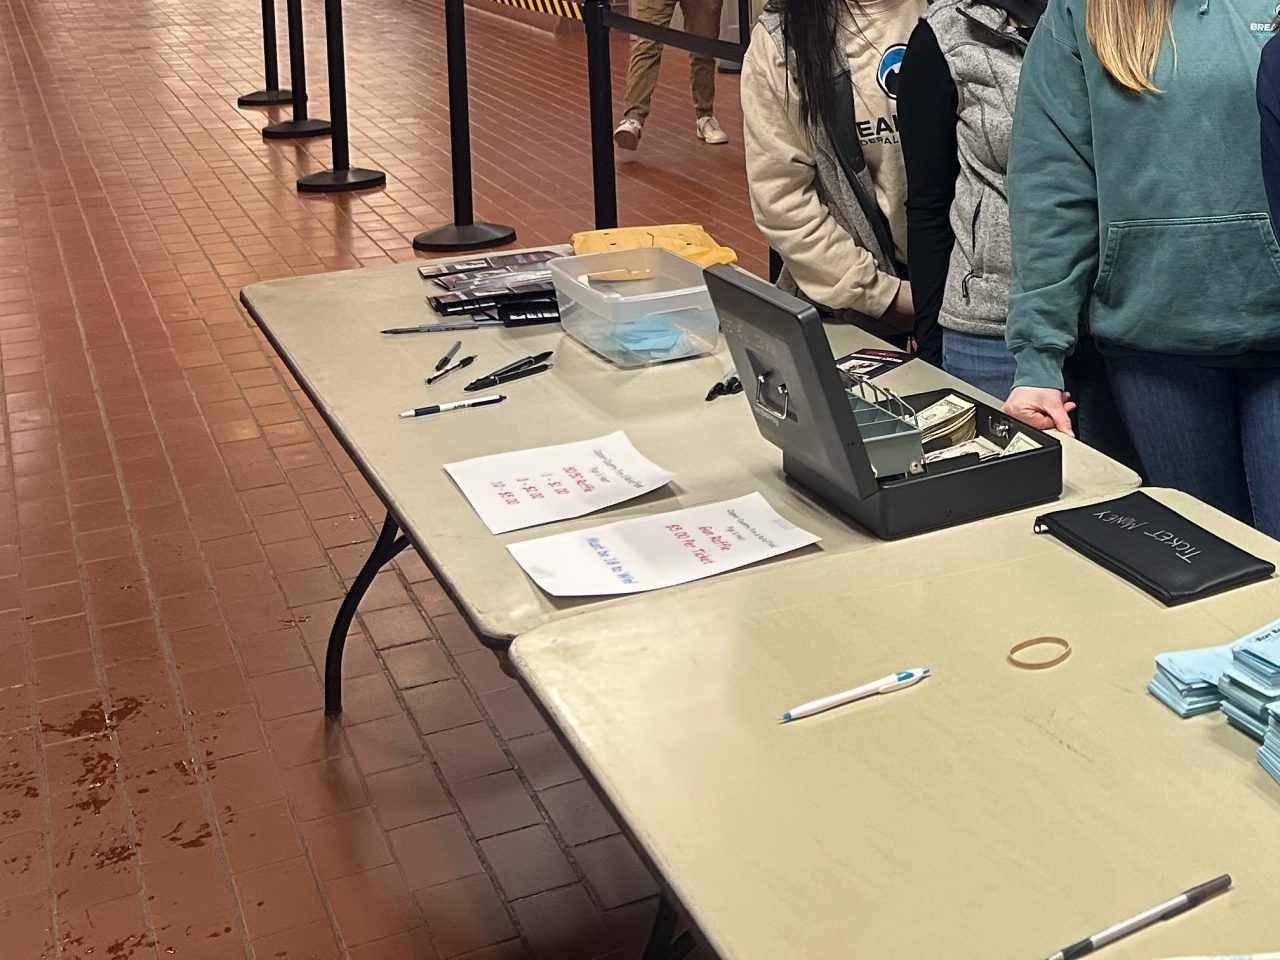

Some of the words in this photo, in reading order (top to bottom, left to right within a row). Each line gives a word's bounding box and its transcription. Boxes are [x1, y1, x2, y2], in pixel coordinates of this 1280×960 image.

[1093, 510, 1149, 531] MONEY
[692, 548, 715, 565] Ticket
[1143, 529, 1203, 564] TICKET
